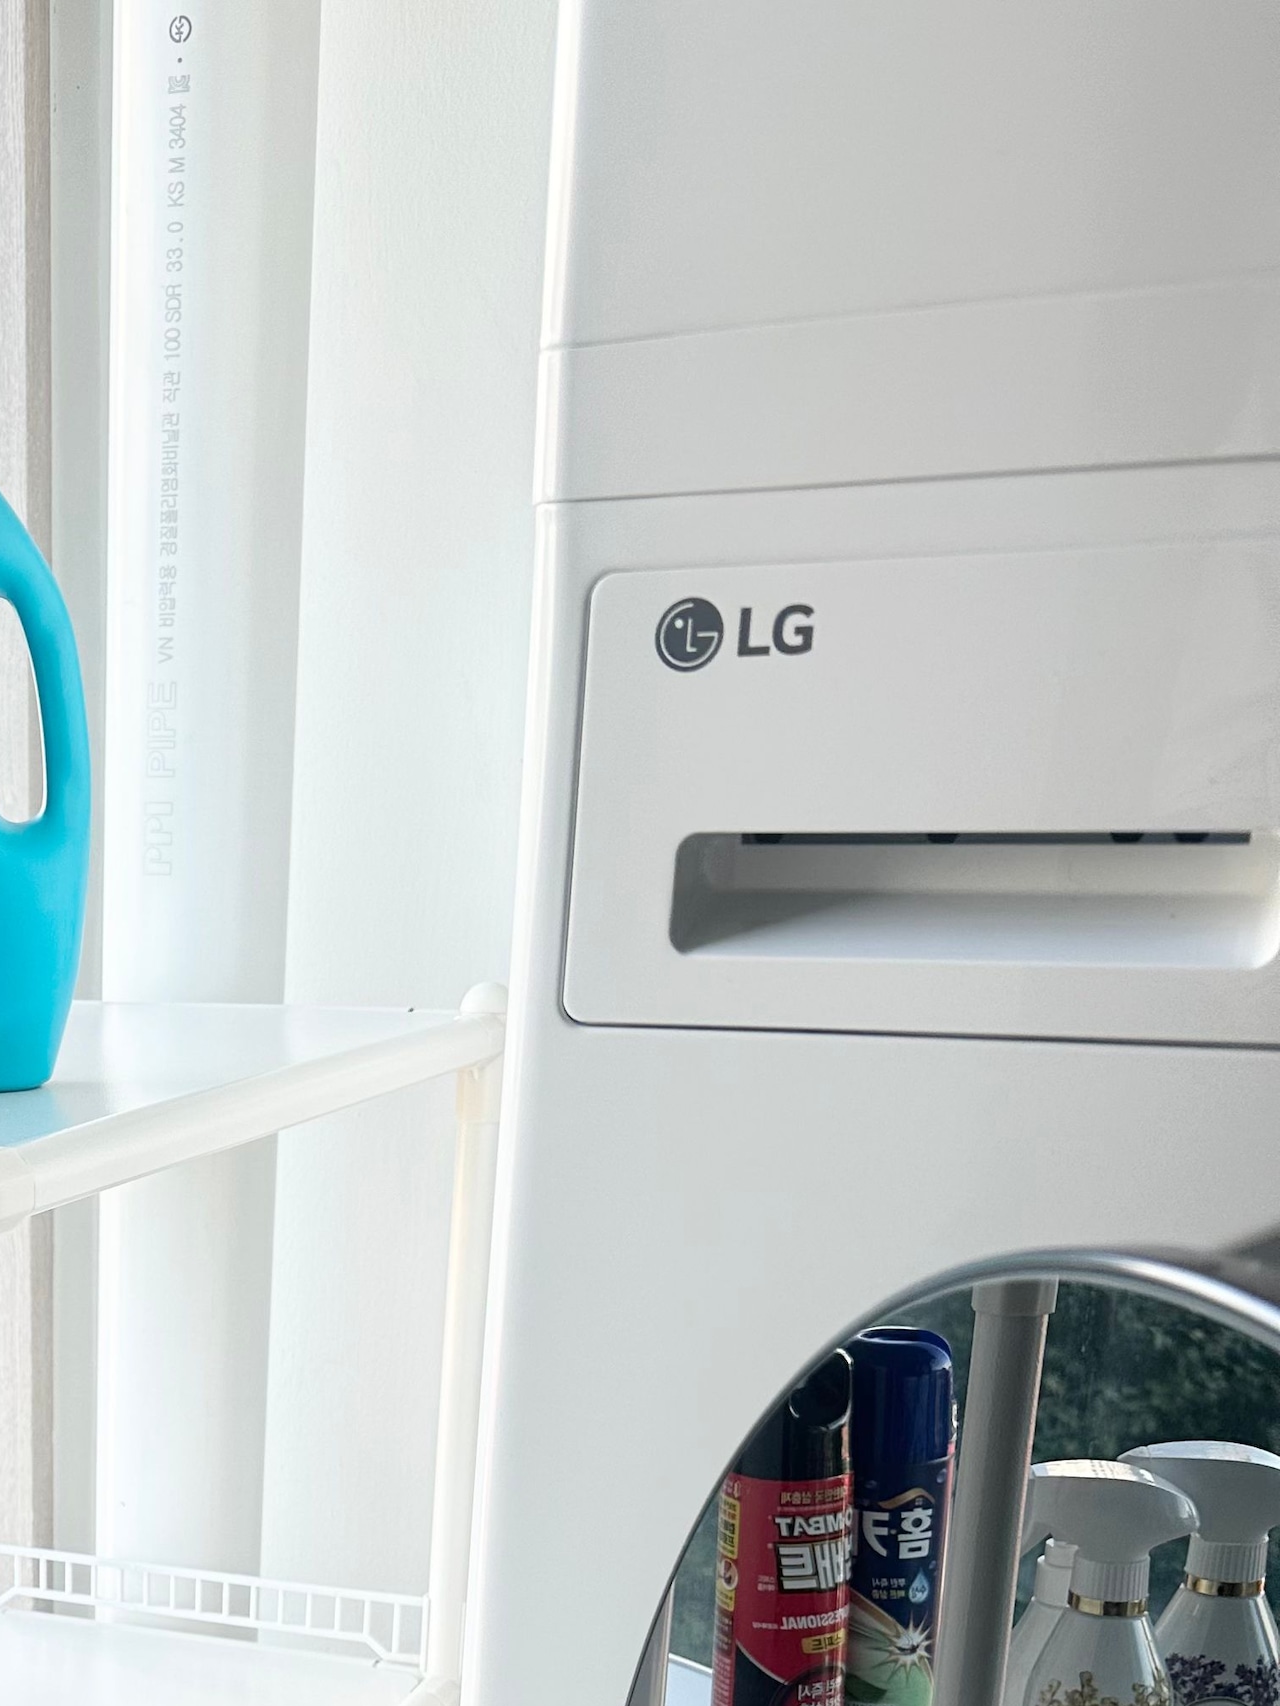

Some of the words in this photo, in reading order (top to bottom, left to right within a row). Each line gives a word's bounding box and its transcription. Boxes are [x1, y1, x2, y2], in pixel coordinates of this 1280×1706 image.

[169, 103, 187, 149] 3404
[168, 156, 185, 173] M
[167, 181, 185, 208] KS
[166, 221, 184, 272] 33.0
[165, 284, 182, 323] SDR
[164, 327, 181, 360] 100
[163, 371, 181, 403] 직관
[737, 604, 815, 657] LG
[158, 636, 173, 664] VN
[145, 681, 177, 778] PIPE
